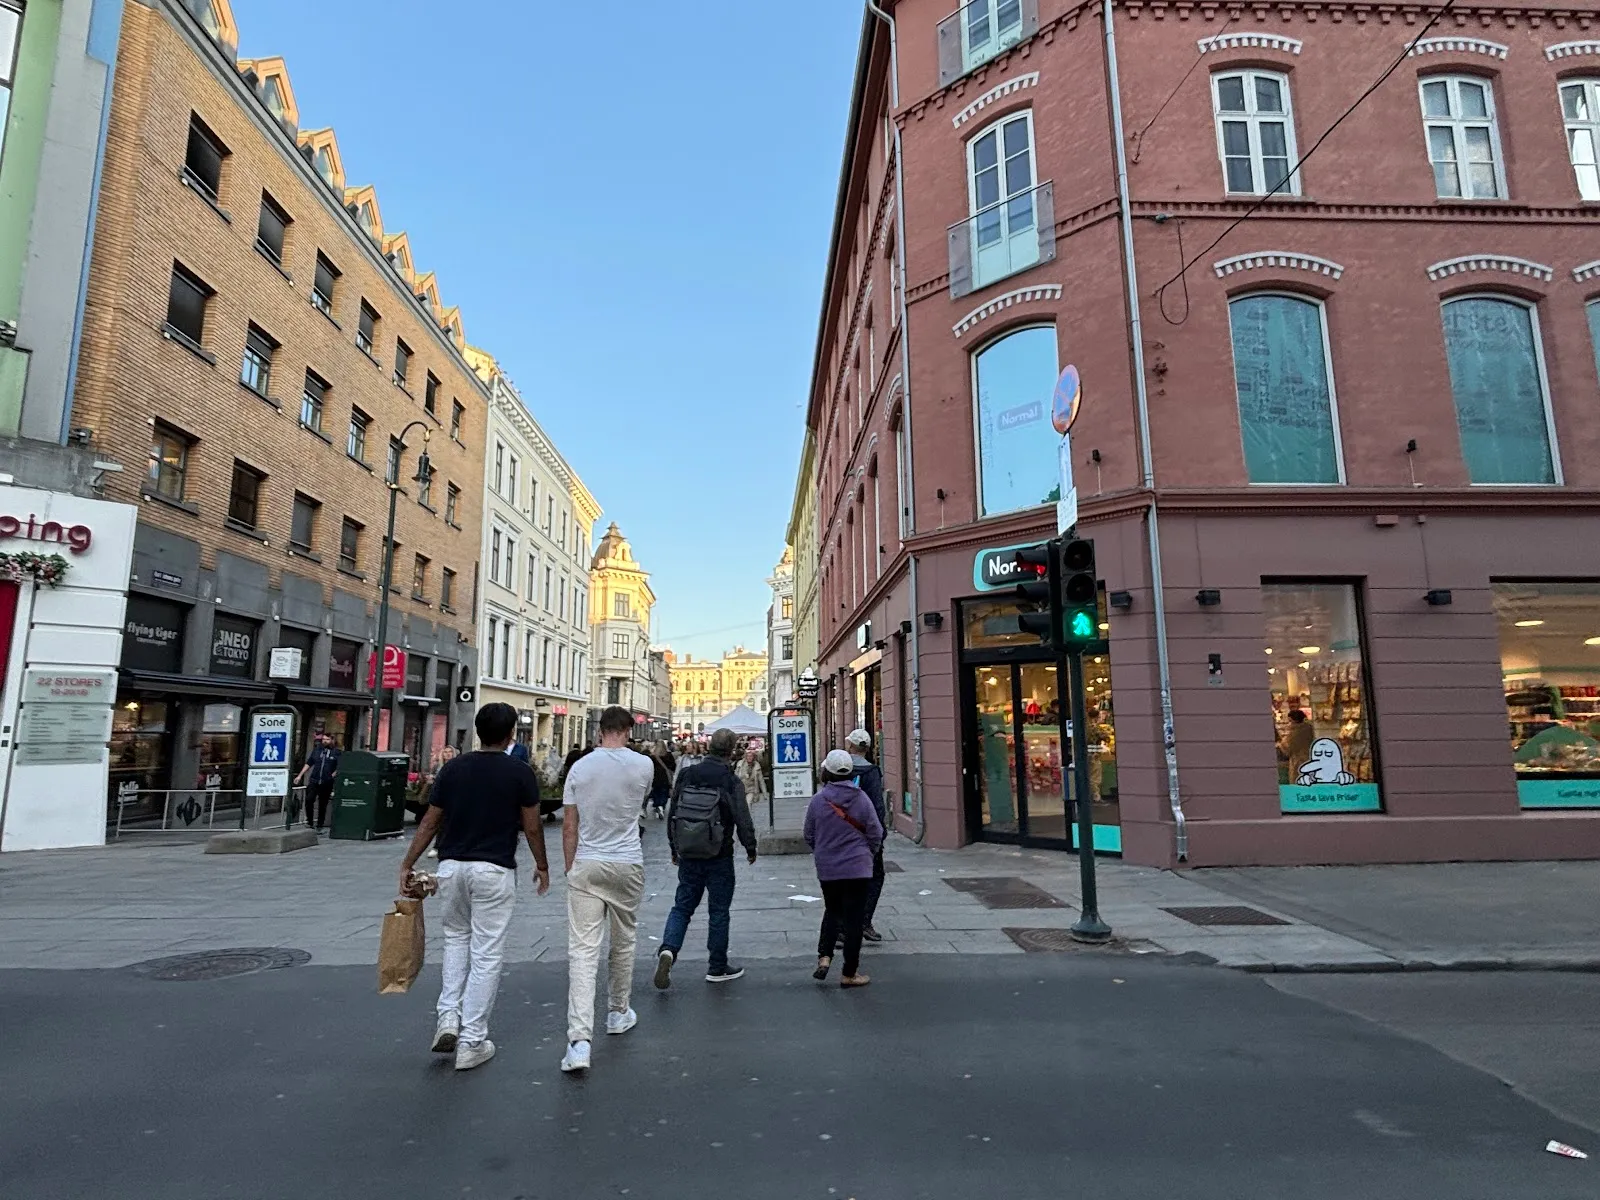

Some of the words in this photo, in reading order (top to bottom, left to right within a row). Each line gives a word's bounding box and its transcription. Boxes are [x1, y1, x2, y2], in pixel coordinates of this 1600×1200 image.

[1001, 405, 1038, 426] Normal
[989, 555, 1021, 577] Nor
[127, 621, 154, 638] flying
[155, 626, 178, 640] tiger
[224, 630, 250, 649] NEO
[223, 647, 249, 660] TOKYO
[54, 677, 103, 687] STORES
[259, 717, 286, 727] Sone
[778, 718, 804, 728] Sone
